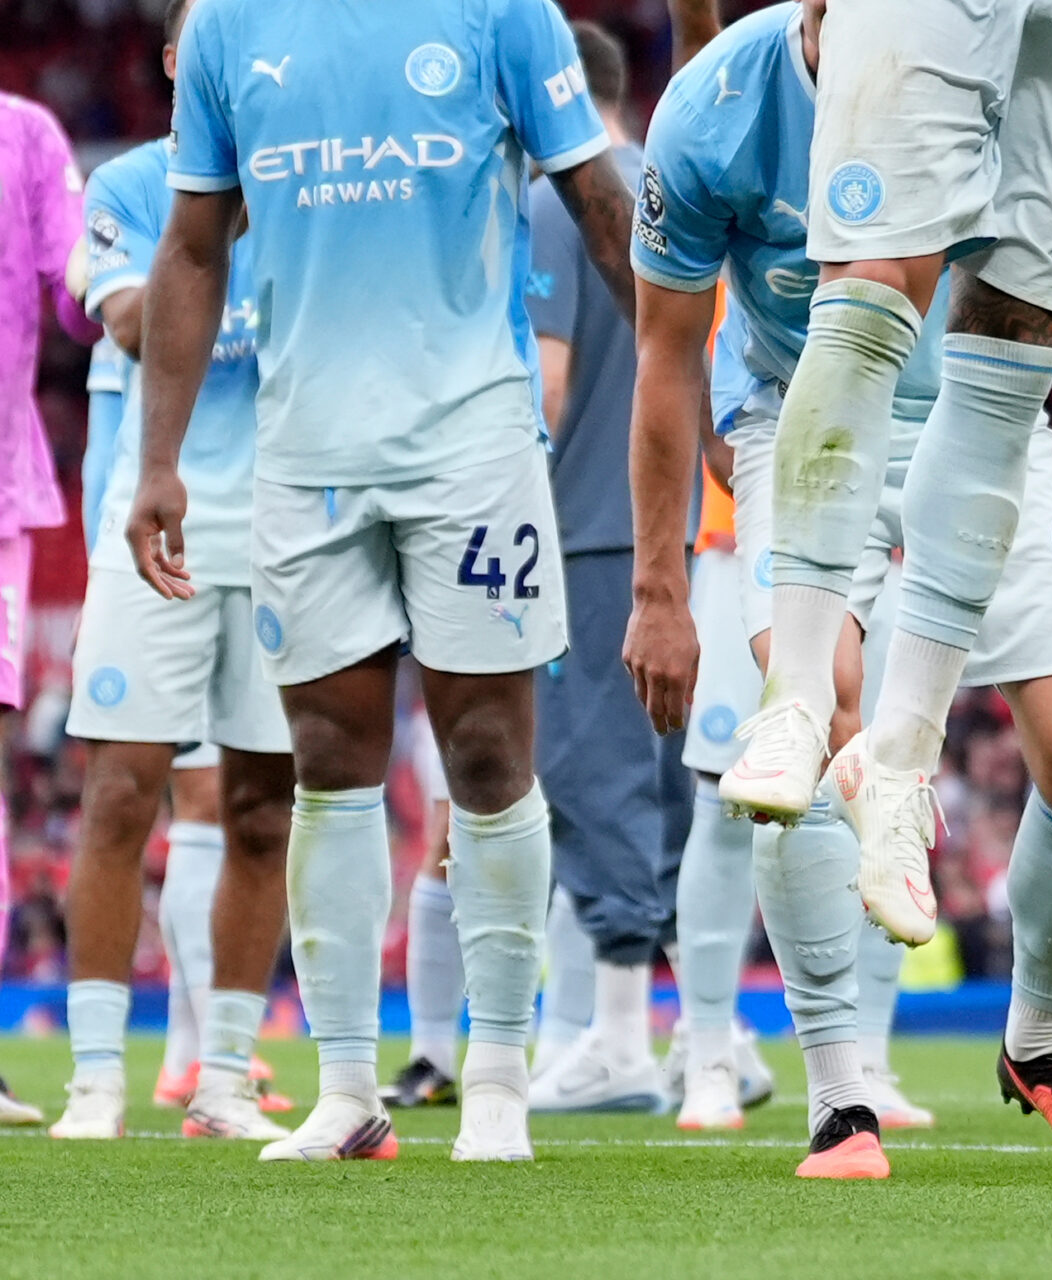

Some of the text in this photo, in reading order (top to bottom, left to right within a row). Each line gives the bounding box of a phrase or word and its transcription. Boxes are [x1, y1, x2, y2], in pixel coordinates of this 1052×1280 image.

[249, 134, 464, 181] ETIHAD
[297, 178, 413, 209] AIRWAYS
[457, 523, 540, 599] 42
